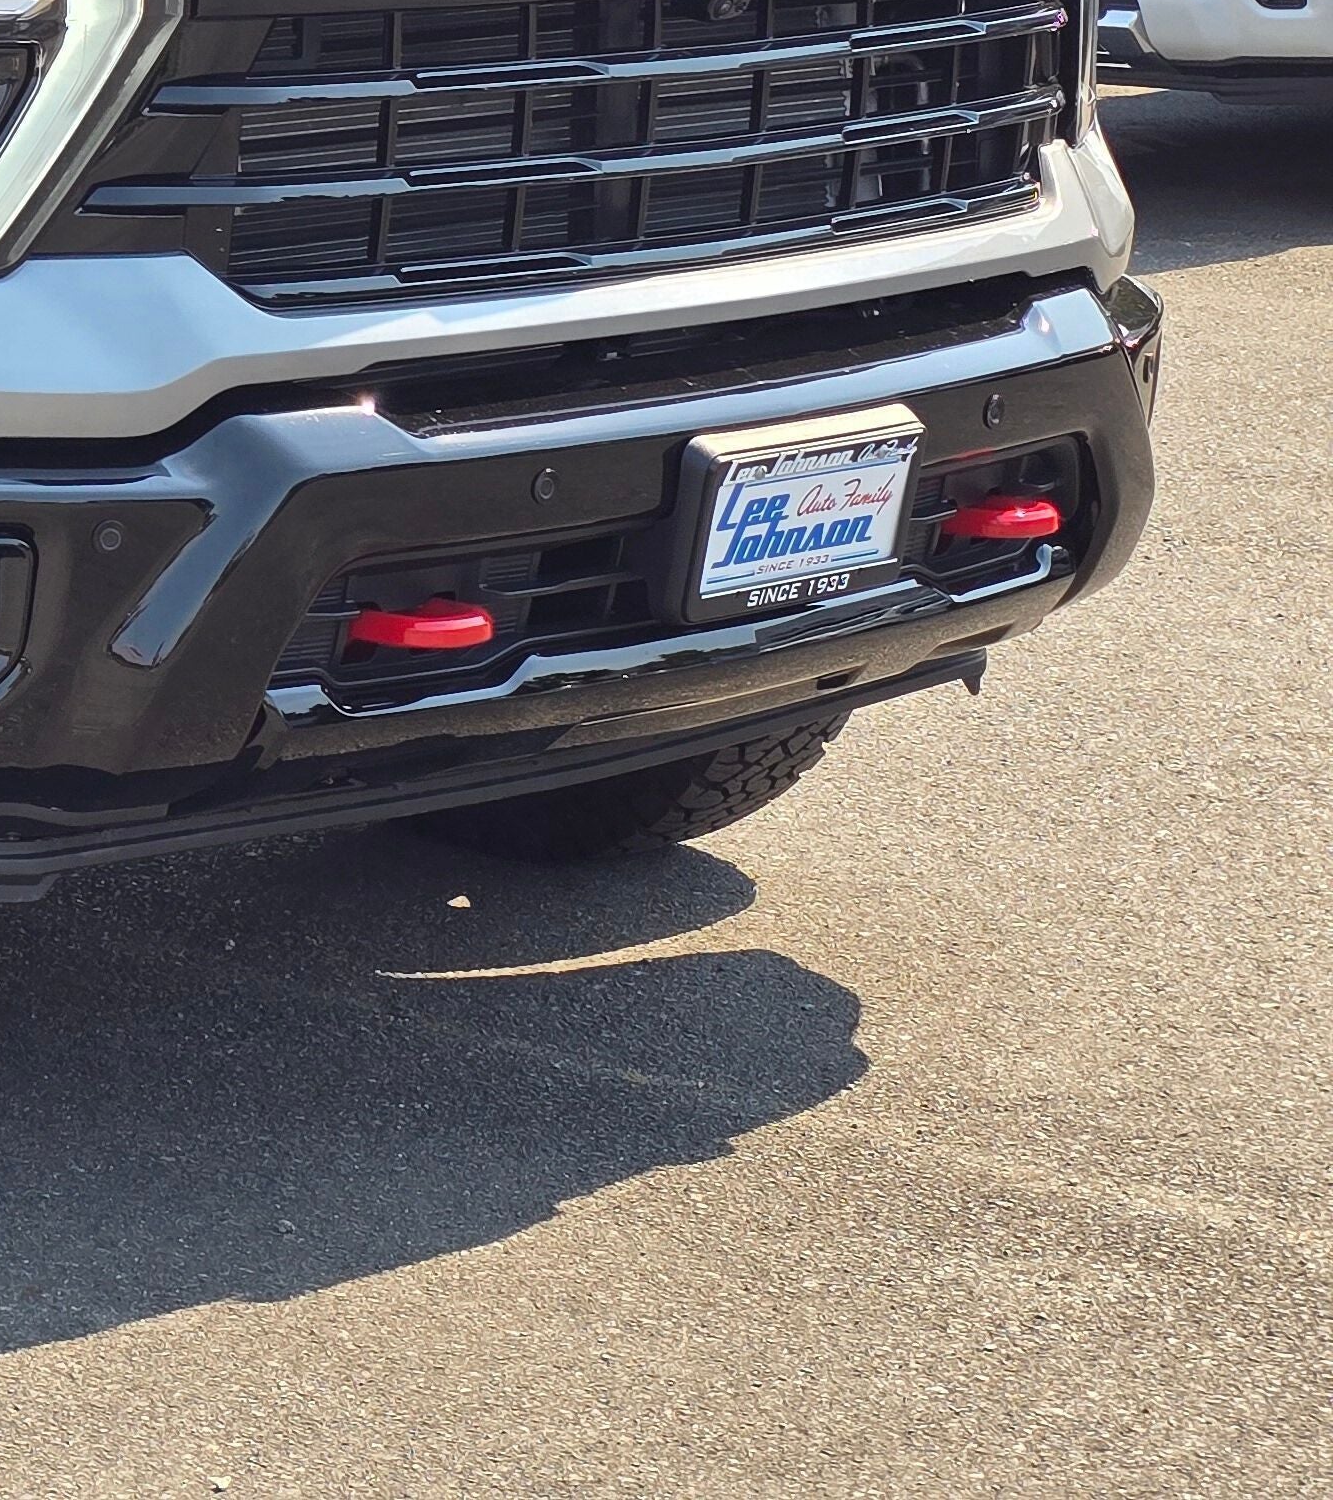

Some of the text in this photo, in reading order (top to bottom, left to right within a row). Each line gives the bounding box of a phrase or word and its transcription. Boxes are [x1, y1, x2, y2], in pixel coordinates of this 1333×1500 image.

[765, 450, 855, 478] Johnson
[716, 474, 896, 532] Lee Auto Family
[711, 514, 874, 570] Johnson
[756, 554, 830, 575] SINCE 1933
[747, 573, 851, 608] SINCE 1933
